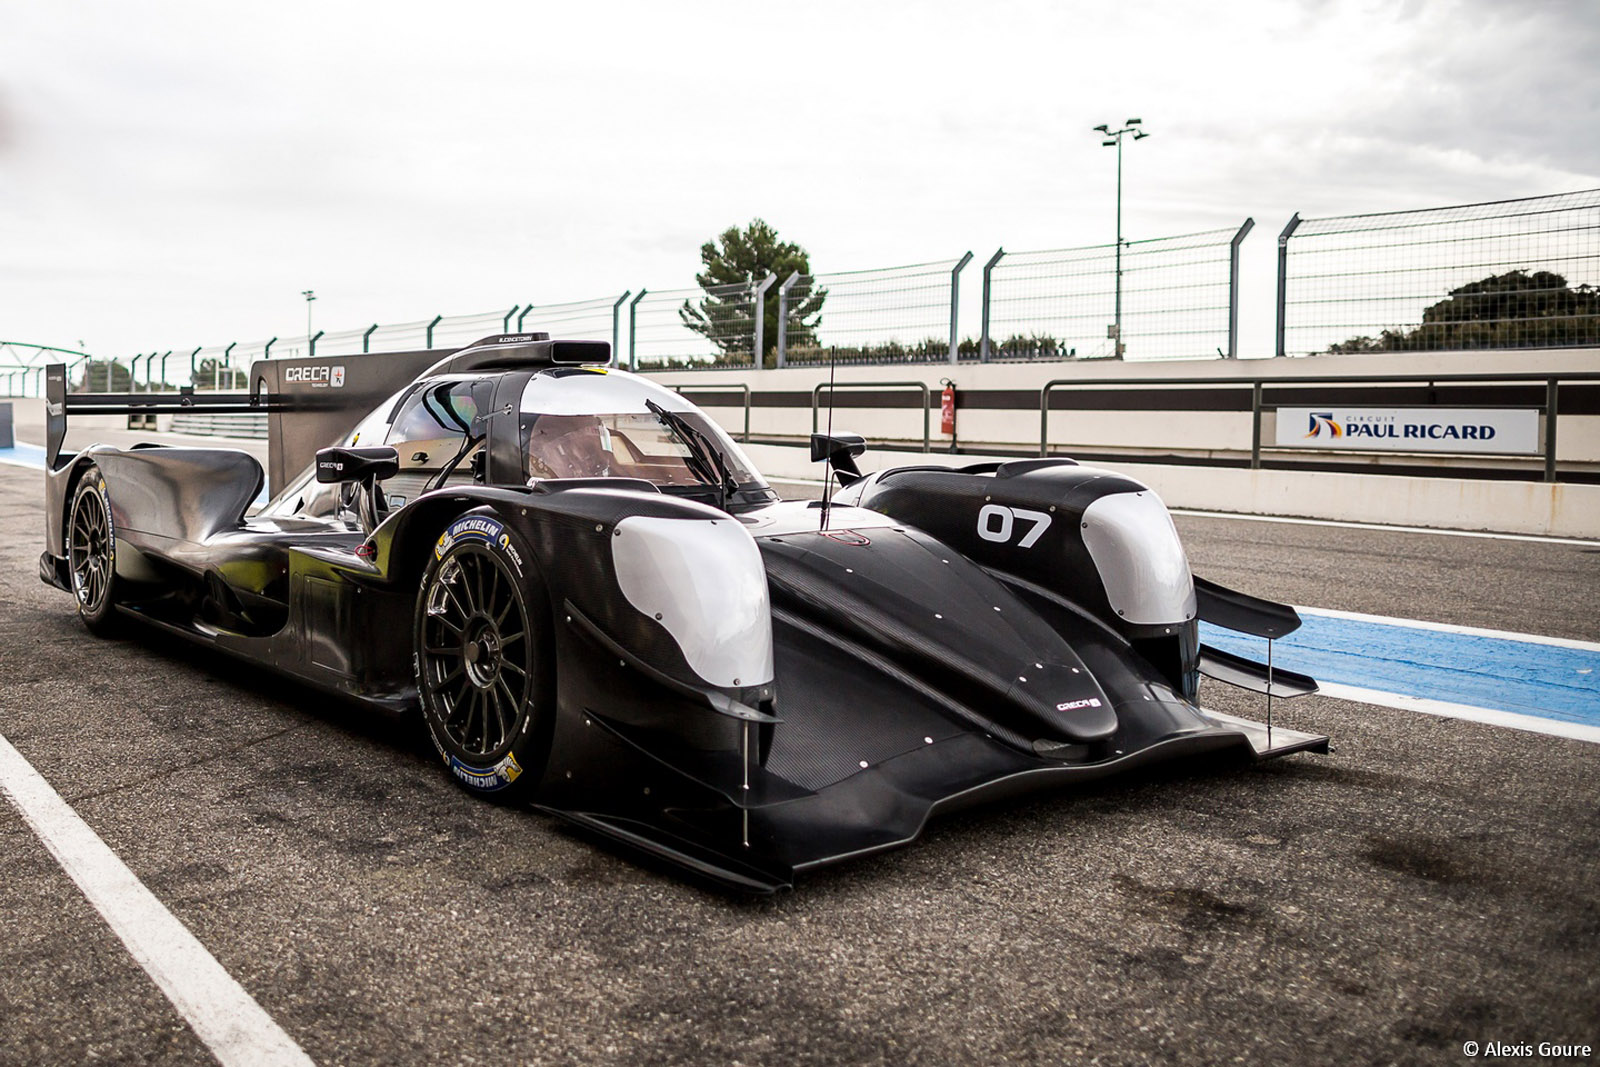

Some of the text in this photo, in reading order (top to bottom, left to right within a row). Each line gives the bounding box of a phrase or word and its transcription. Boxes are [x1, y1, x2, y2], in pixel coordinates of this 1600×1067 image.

[285, 366, 330, 381] ORECA
[1346, 423, 1496, 440] PAUL RICARD
[452, 519, 499, 536] MICHELIN
[977, 504, 1052, 549] 07
[453, 765, 498, 788] MICHELIN
